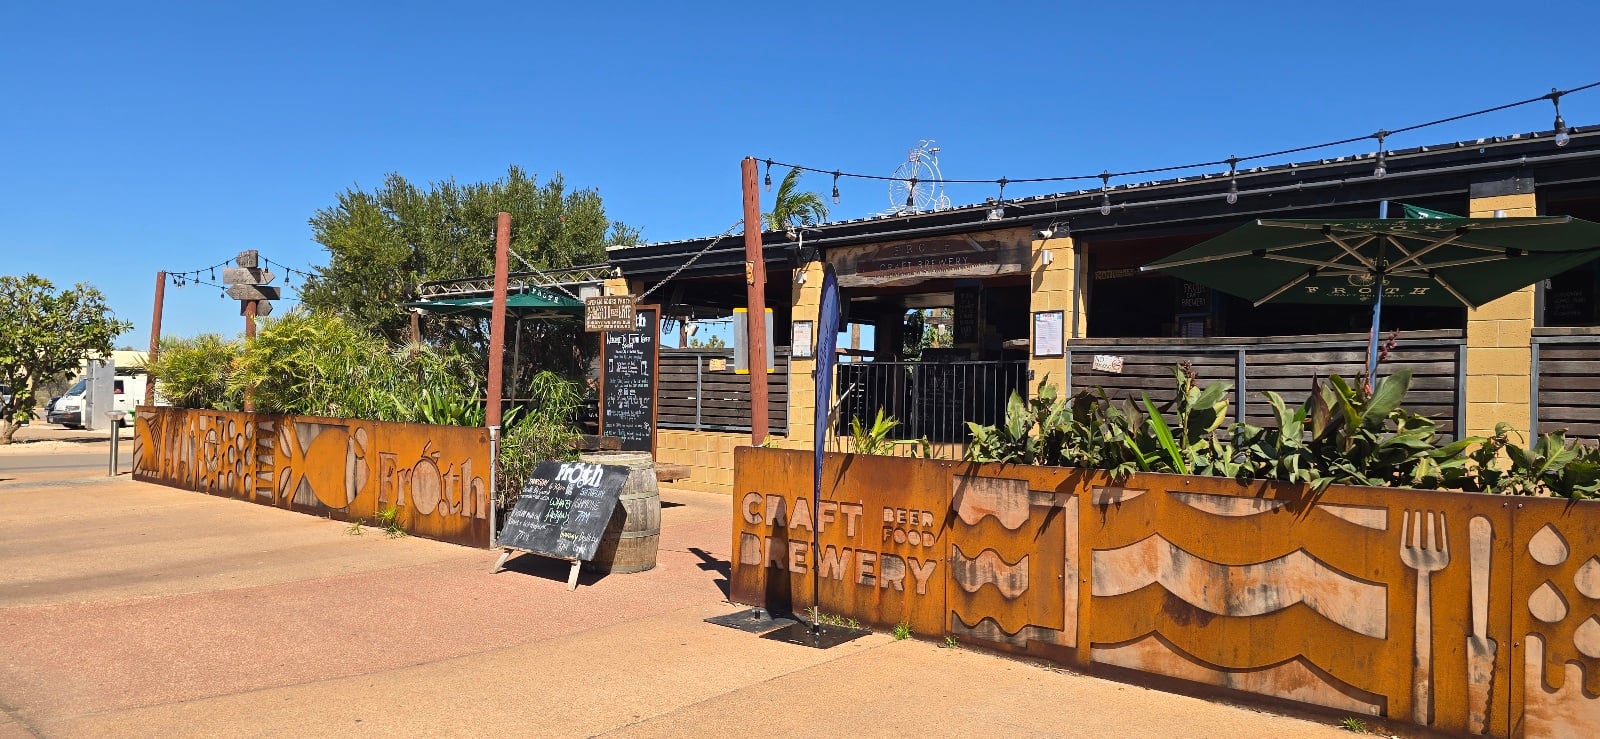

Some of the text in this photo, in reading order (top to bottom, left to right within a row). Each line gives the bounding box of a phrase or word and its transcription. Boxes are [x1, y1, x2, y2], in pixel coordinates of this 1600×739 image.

[917, 256, 969, 267] BREWERY
[1304, 286, 1431, 295] FROTH
[378, 441, 487, 520] Froth
[554, 463, 604, 488] Froth
[742, 491, 864, 536] CRAFT
[882, 506, 934, 527] BEER
[882, 526, 935, 547] FOOD
[739, 530, 937, 595] BREWERY
